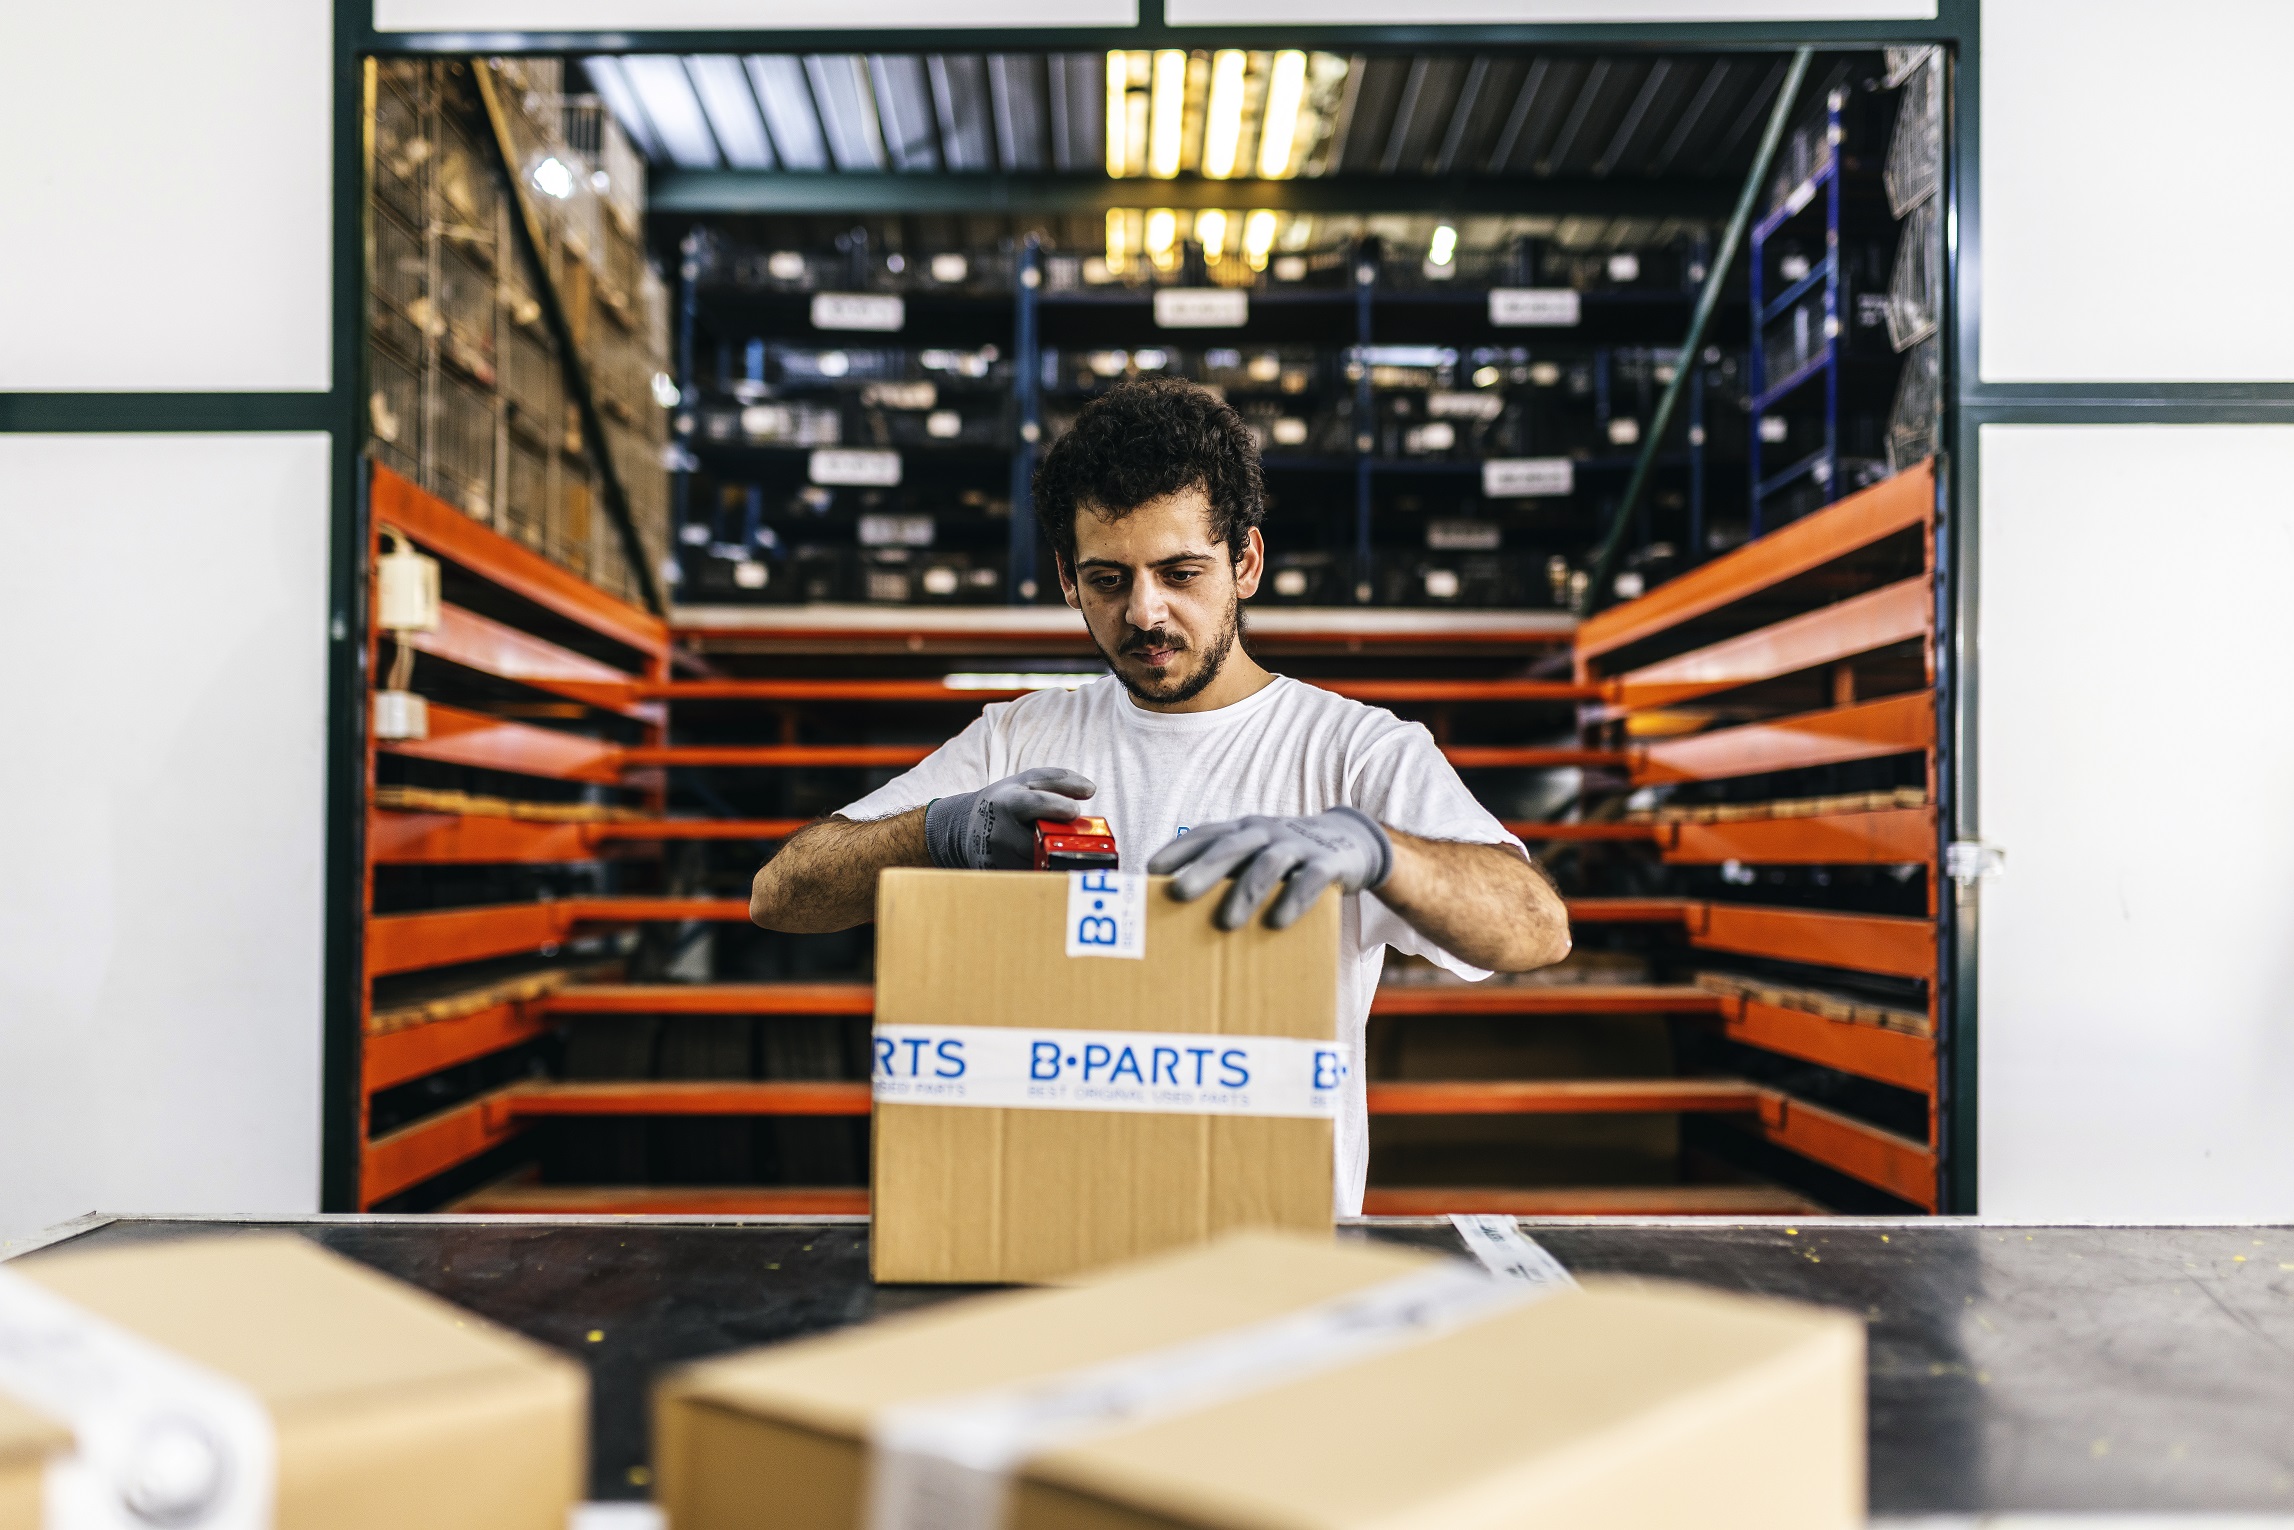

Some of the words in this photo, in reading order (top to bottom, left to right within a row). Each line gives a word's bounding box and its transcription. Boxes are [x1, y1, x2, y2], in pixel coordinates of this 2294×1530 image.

[1027, 1084, 1067, 1099] BEST
[1151, 1088, 1194, 1105] USED
[1199, 1091, 1250, 1107] PARTS
